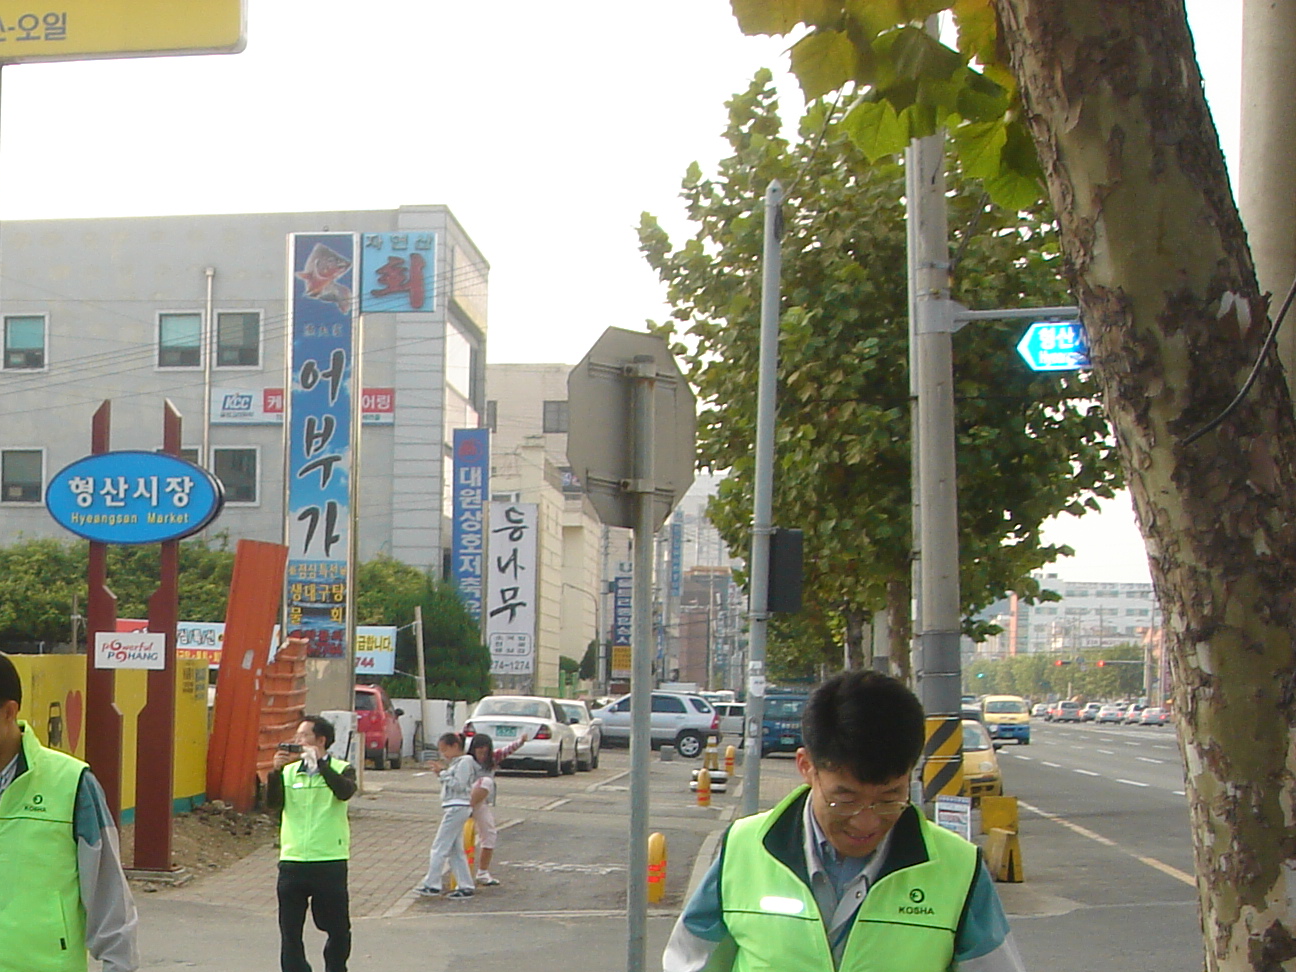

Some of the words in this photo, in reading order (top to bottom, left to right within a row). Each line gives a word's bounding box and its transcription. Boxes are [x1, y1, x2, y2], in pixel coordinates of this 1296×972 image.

[365, 234, 433, 250] 자연산
[370, 252, 426, 309] 회
[225, 394, 251, 410] KCC
[296, 349, 346, 558] 어부가
[68, 475, 194, 507] 형산시장
[147, 512, 189, 524] Market
[291, 583, 345, 602] 생대구탕
[898, 906, 935, 915] KOSHA
